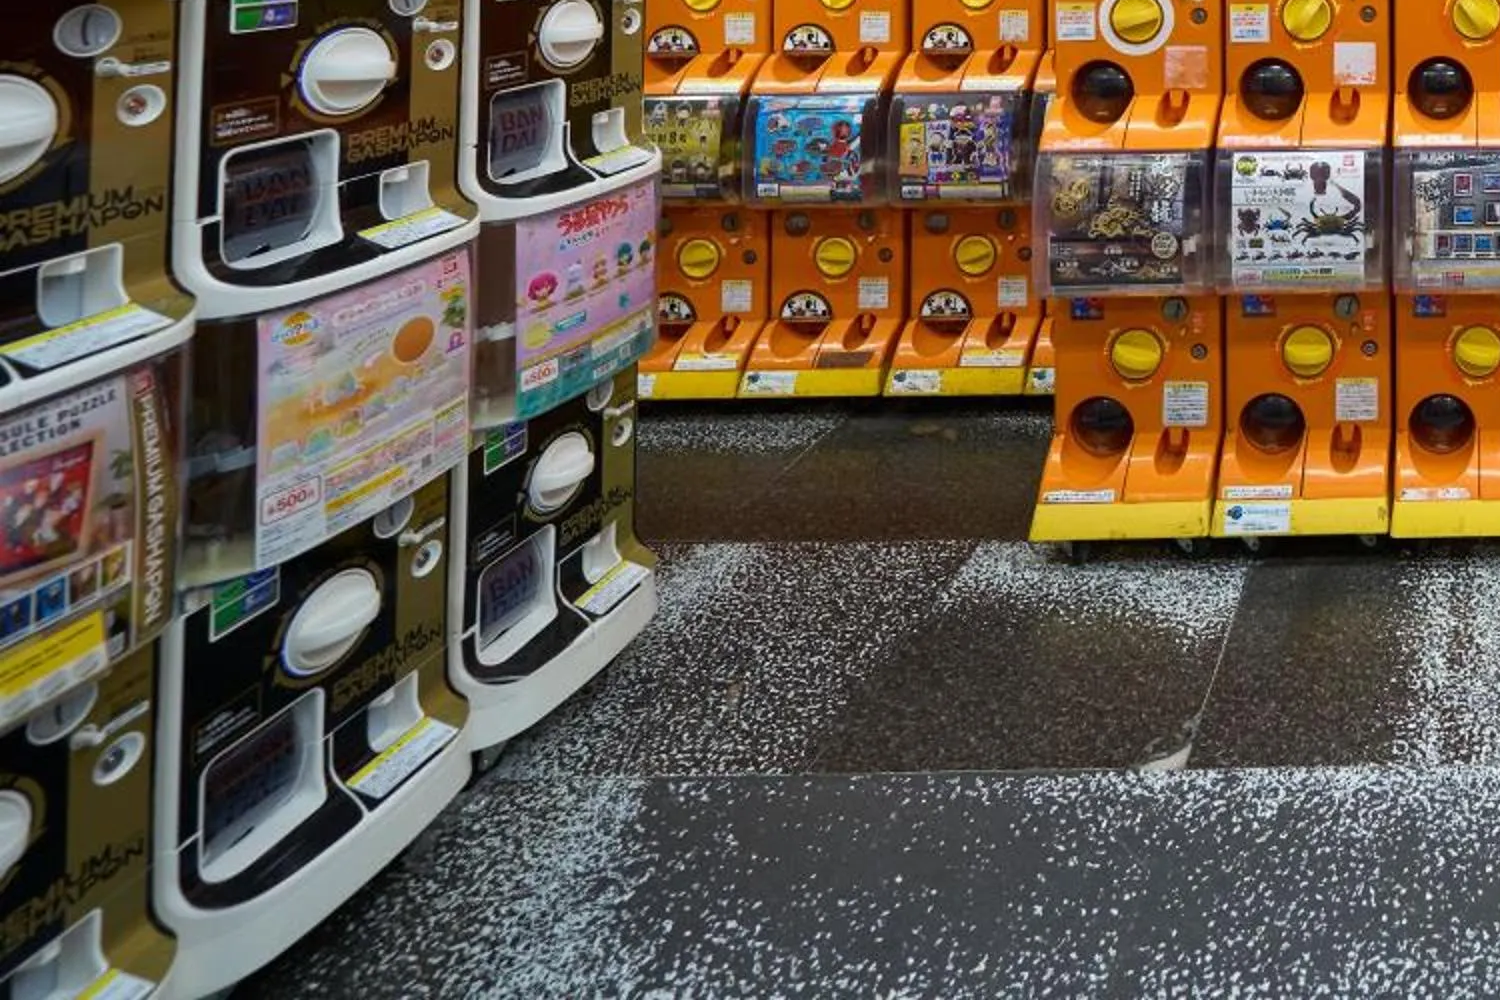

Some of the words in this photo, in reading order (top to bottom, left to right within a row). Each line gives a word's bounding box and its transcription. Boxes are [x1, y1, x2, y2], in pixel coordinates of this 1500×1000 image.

[347, 117, 437, 149] PREMIUM
[347, 125, 454, 164] GASHAPON
[0, 194, 164, 251] ASHAPON
[56, 389, 116, 422] PUZZLE
[145, 496, 166, 626] GASHAPON
